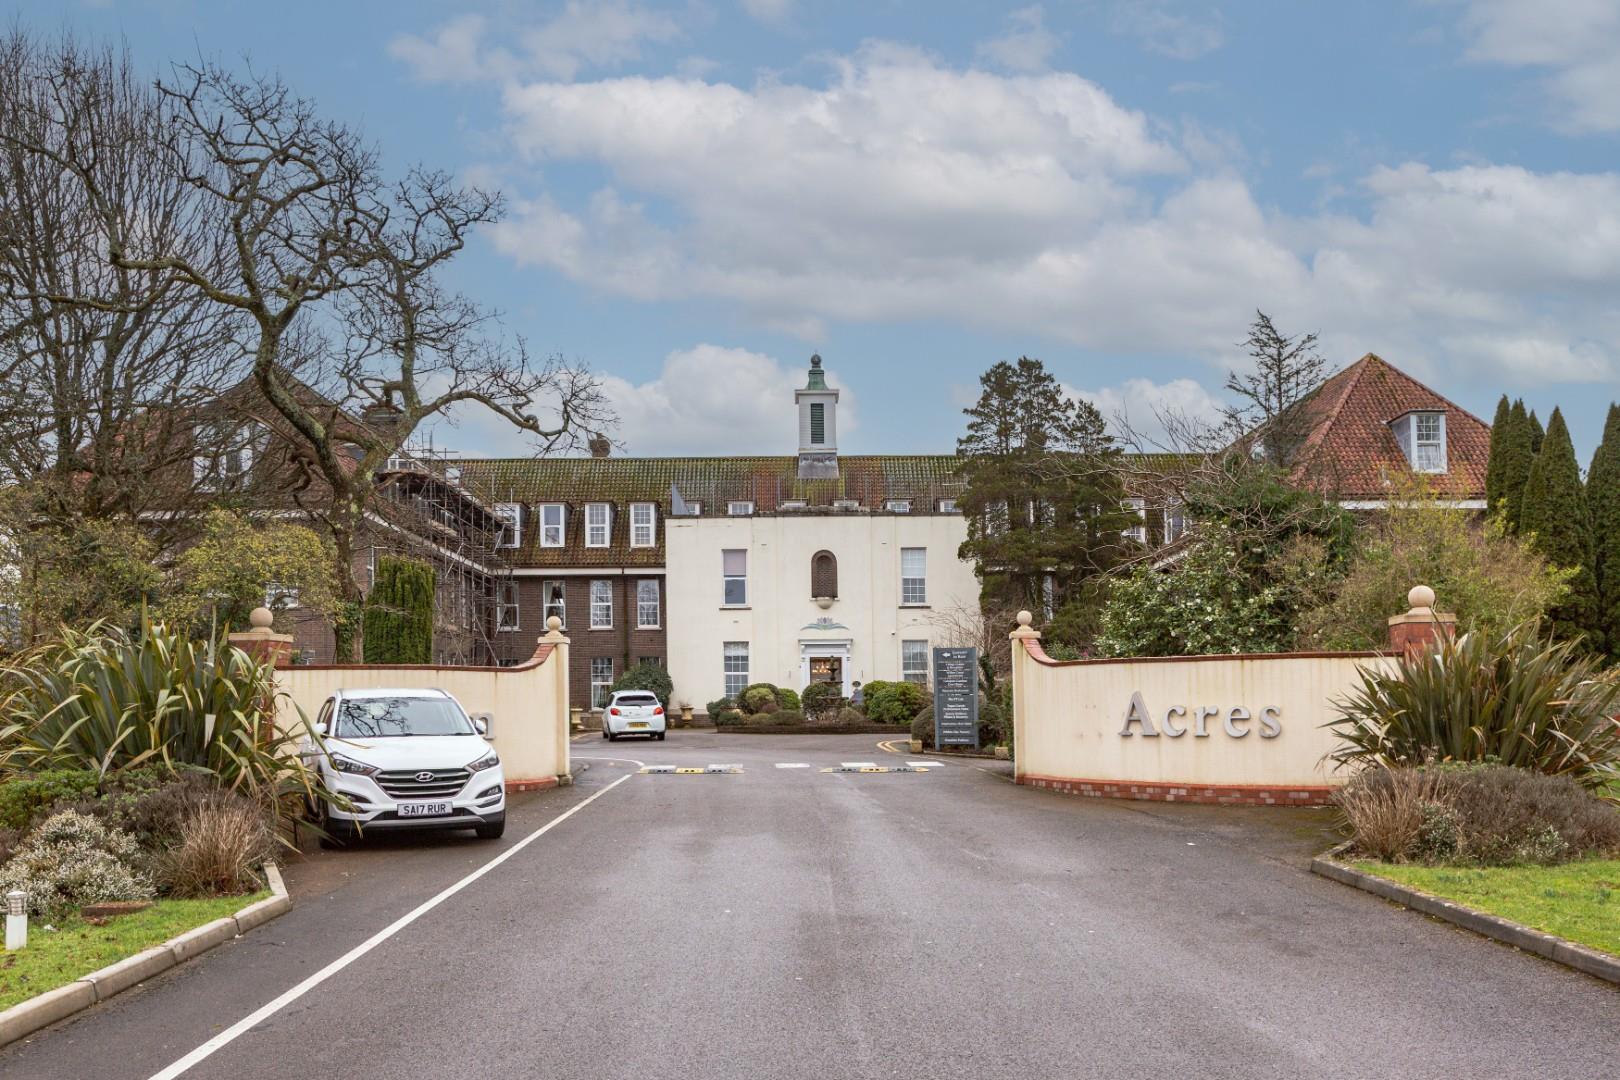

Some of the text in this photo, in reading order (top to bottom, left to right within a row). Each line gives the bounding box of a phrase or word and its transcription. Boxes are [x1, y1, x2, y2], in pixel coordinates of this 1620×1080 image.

[1118, 691, 1282, 739] Acres
[403, 803, 447, 815] SA17 RUR
